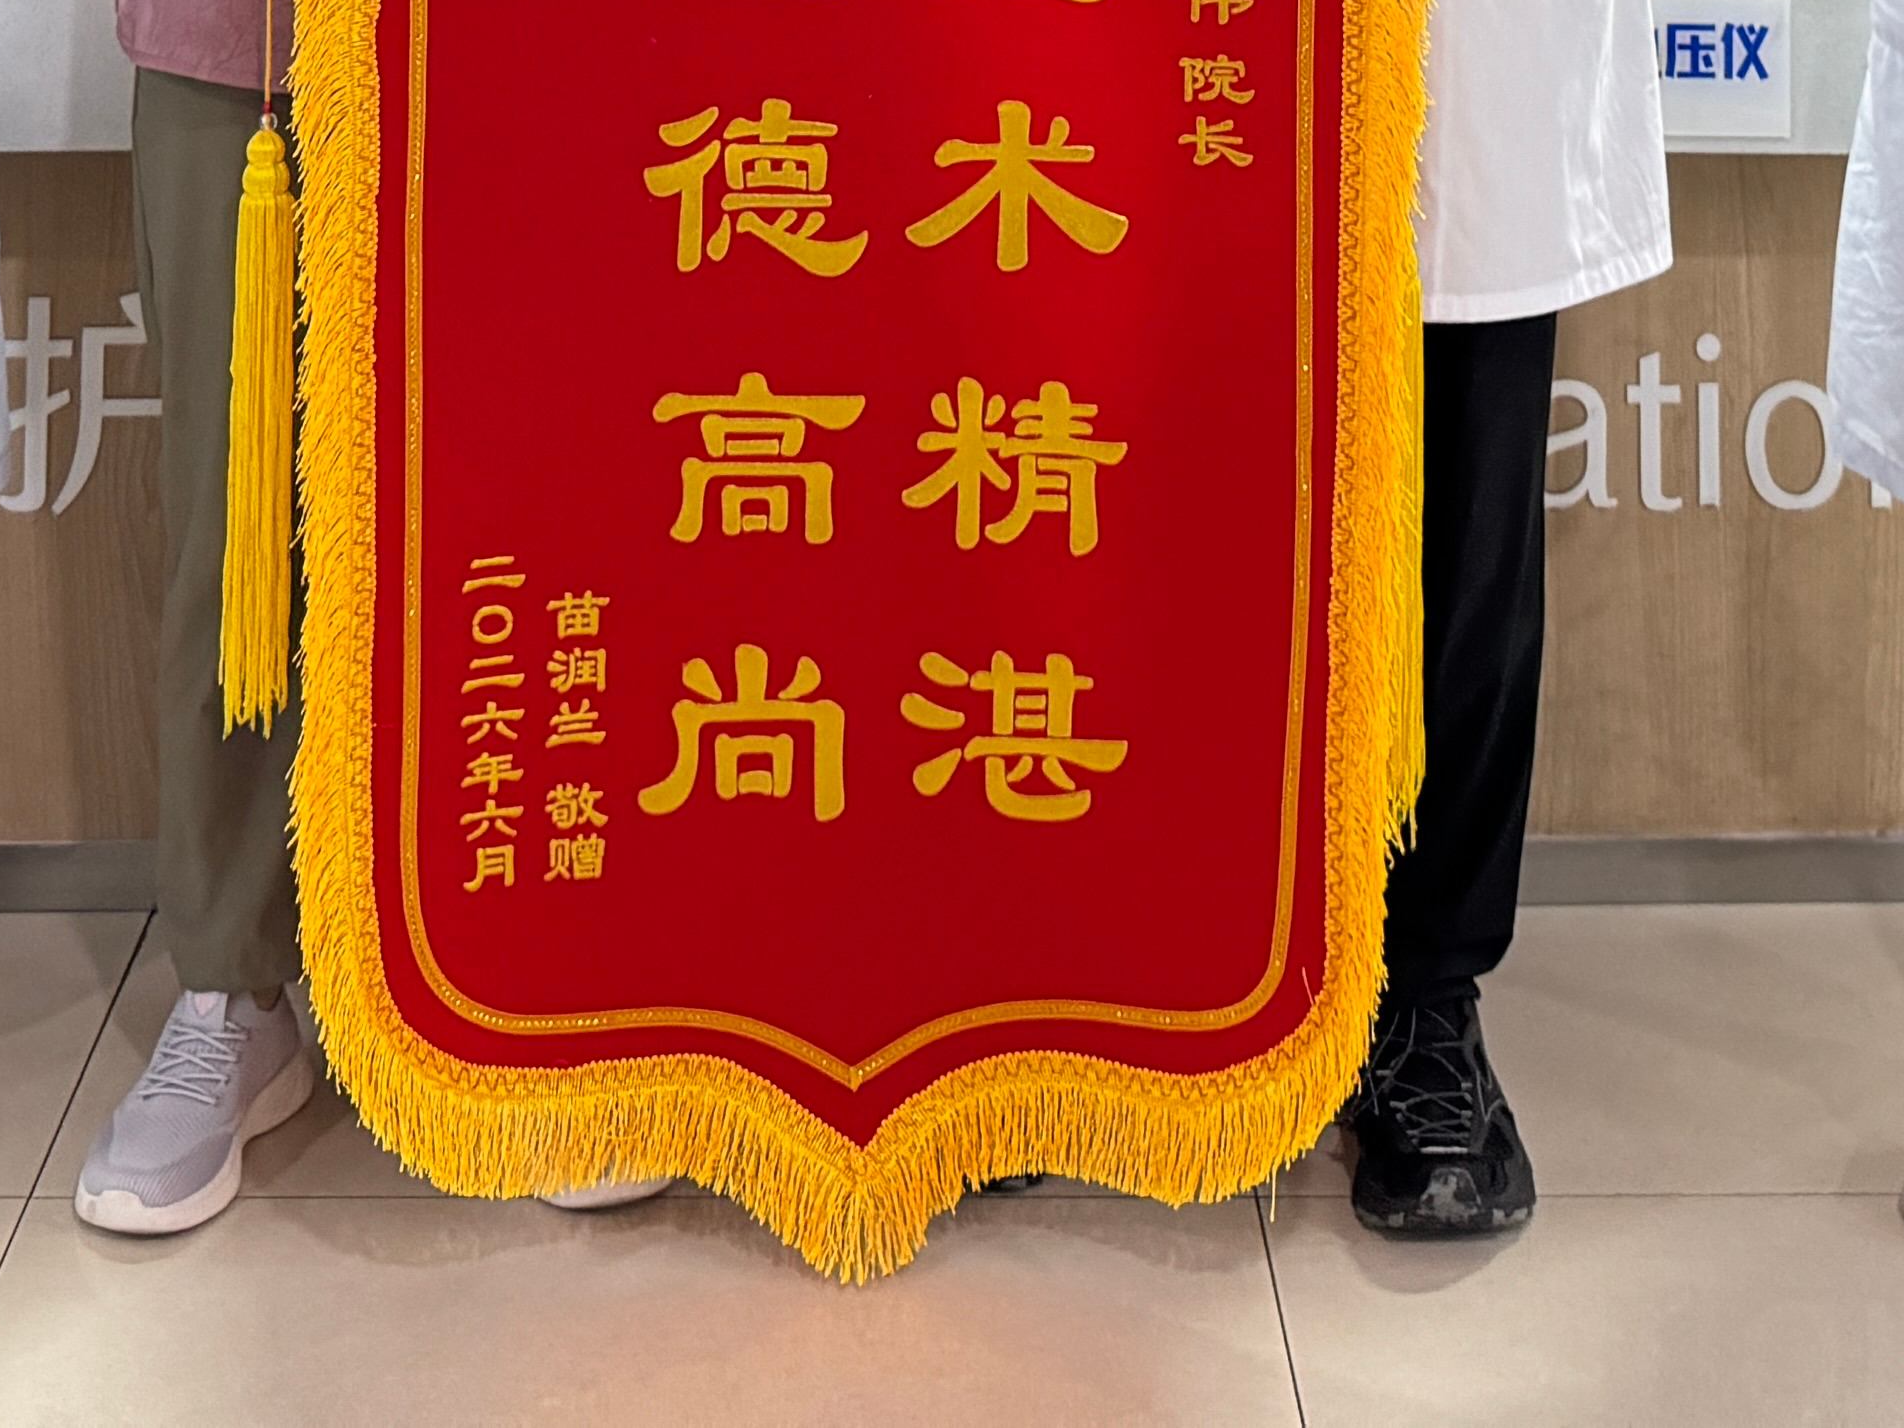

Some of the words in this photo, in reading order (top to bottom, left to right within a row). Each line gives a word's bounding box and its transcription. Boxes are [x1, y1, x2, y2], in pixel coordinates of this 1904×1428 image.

[1655, 23, 1769, 80] 压仪
[1178, 56, 1256, 168] 院长
[1544, 333, 1892, 511] atio
[544, 590, 610, 749] 苗润兰
[544, 782, 608, 881] 敬赠
